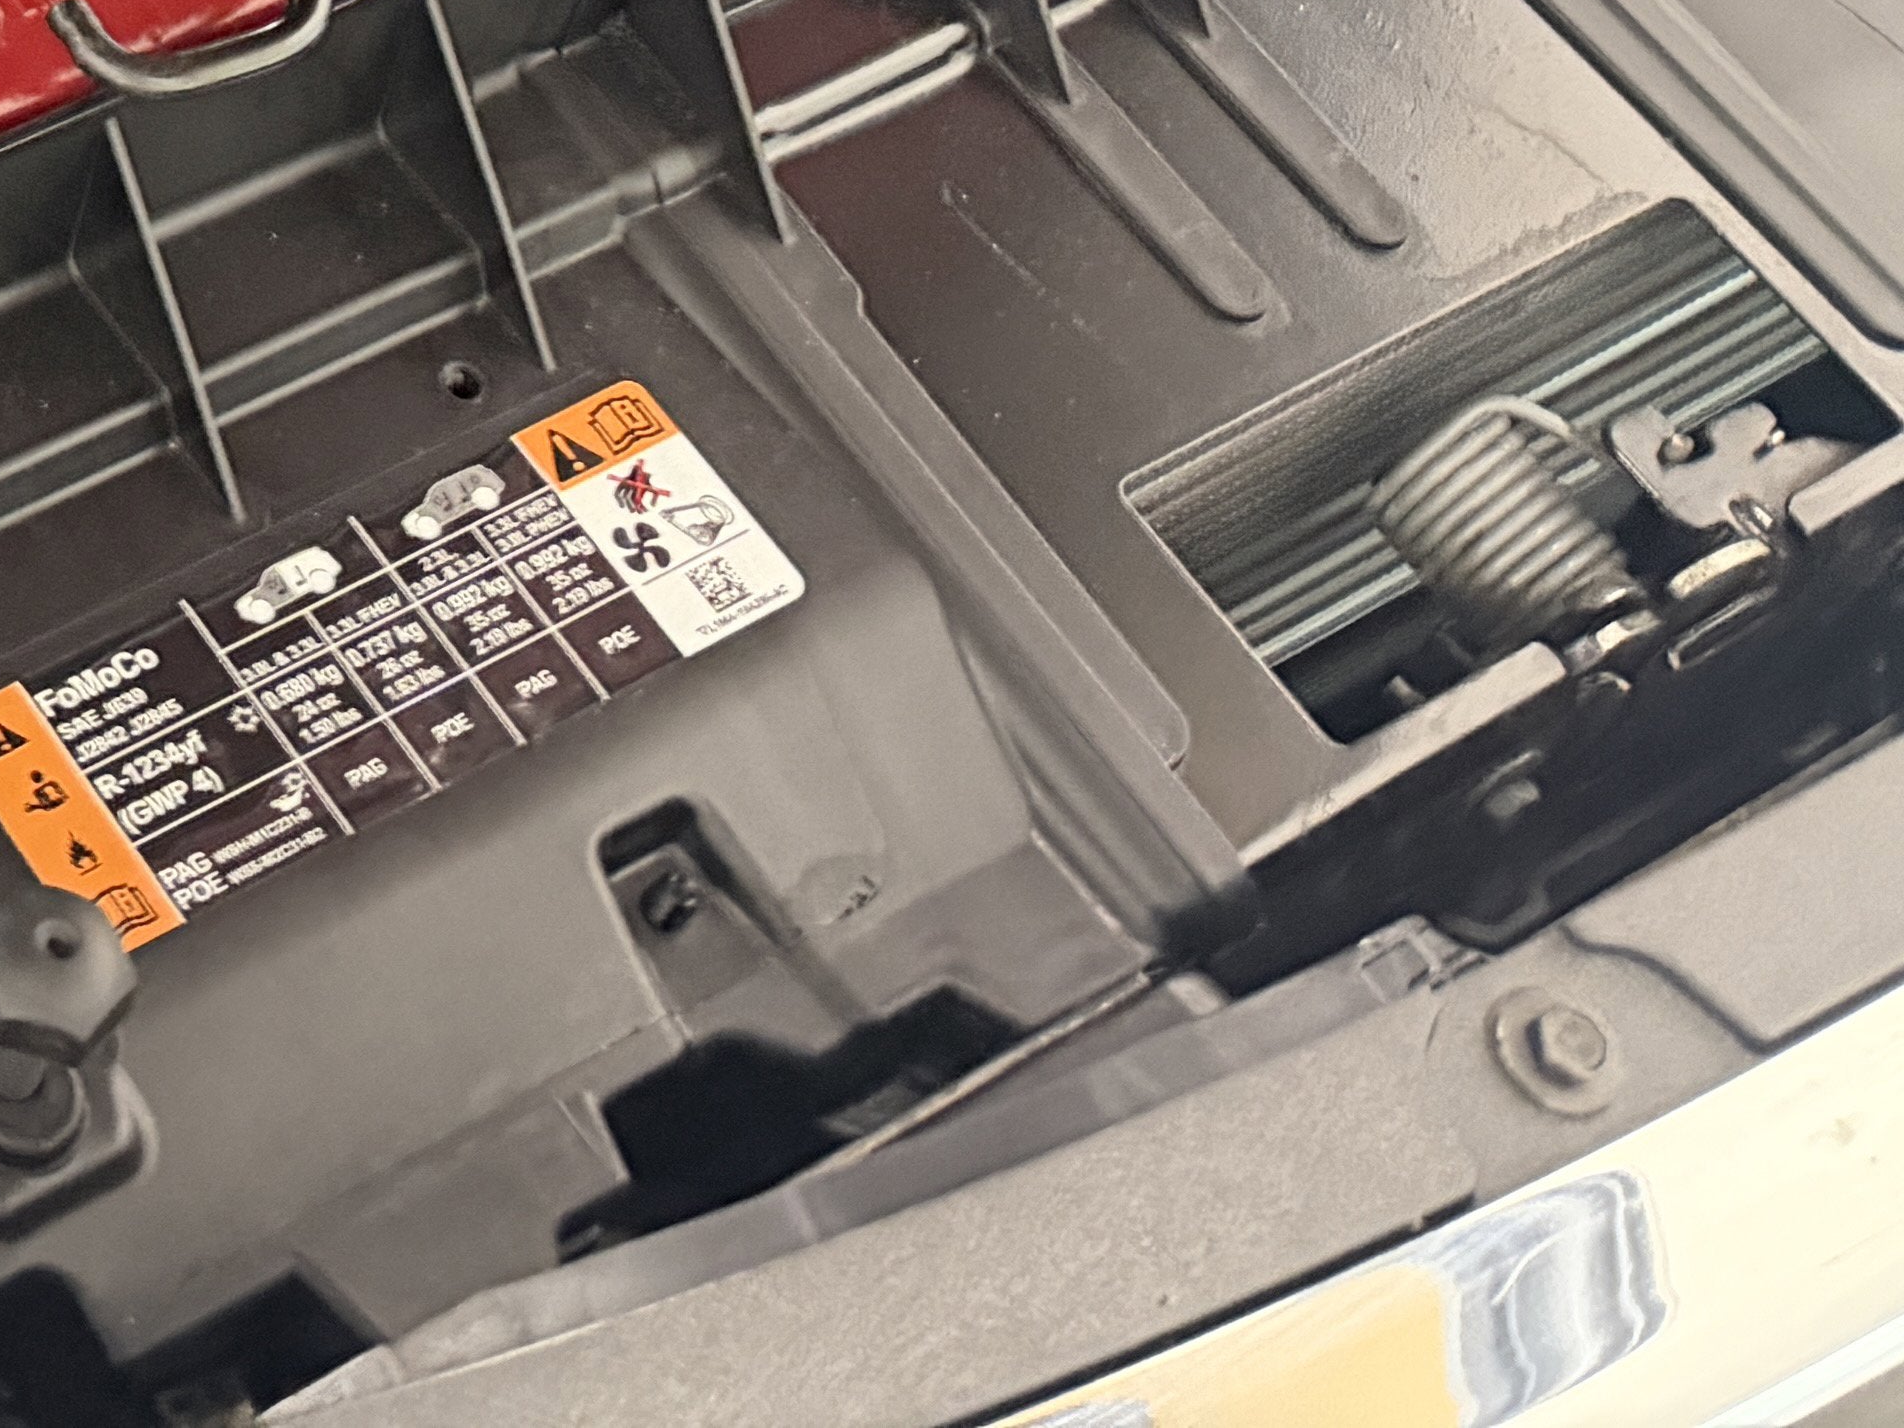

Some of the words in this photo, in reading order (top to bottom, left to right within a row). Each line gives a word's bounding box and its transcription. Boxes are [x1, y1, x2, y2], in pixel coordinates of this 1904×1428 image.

[514, 544, 568, 579] 0.992
[561, 535, 595, 555] kg
[545, 570, 572, 591] 35
[568, 562, 592, 580] oz
[583, 577, 614, 596] lbs
[325, 616, 363, 638] 3.3L
[356, 593, 400, 622] FHEV
[432, 583, 487, 620] 0.992
[477, 575, 514, 597] kg
[463, 610, 491, 632] 35
[486, 603, 510, 621] oz
[502, 618, 533, 638] lbs
[344, 630, 395, 667] 0.737
[392, 621, 427, 643] kg
[598, 624, 640, 654] POE
[33, 648, 158, 716] FoMoCo
[375, 657, 403, 678] 26
[399, 650, 423, 667] oz
[414, 665, 445, 685] lbs
[260, 673, 315, 710] 0.680
[308, 663, 344, 685] kg
[514, 669, 557, 697] PAG
[56, 709, 103, 739] SAE
[102, 687, 147, 719] J639
[291, 700, 319, 722] 24
[315, 692, 340, 710] oz
[298, 717, 338, 742] 1.50
[331, 707, 362, 727] lbs
[76, 725, 129, 762] J2842
[129, 698, 183, 735] J2845
[430, 712, 473, 742] POE
[93, 729, 207, 799] R-1234yf
[344, 757, 387, 787] PAG
[116, 779, 188, 834] (GWP
[192, 765, 224, 792] 4)
[157, 851, 212, 889] PAG
[172, 871, 228, 909] POE
